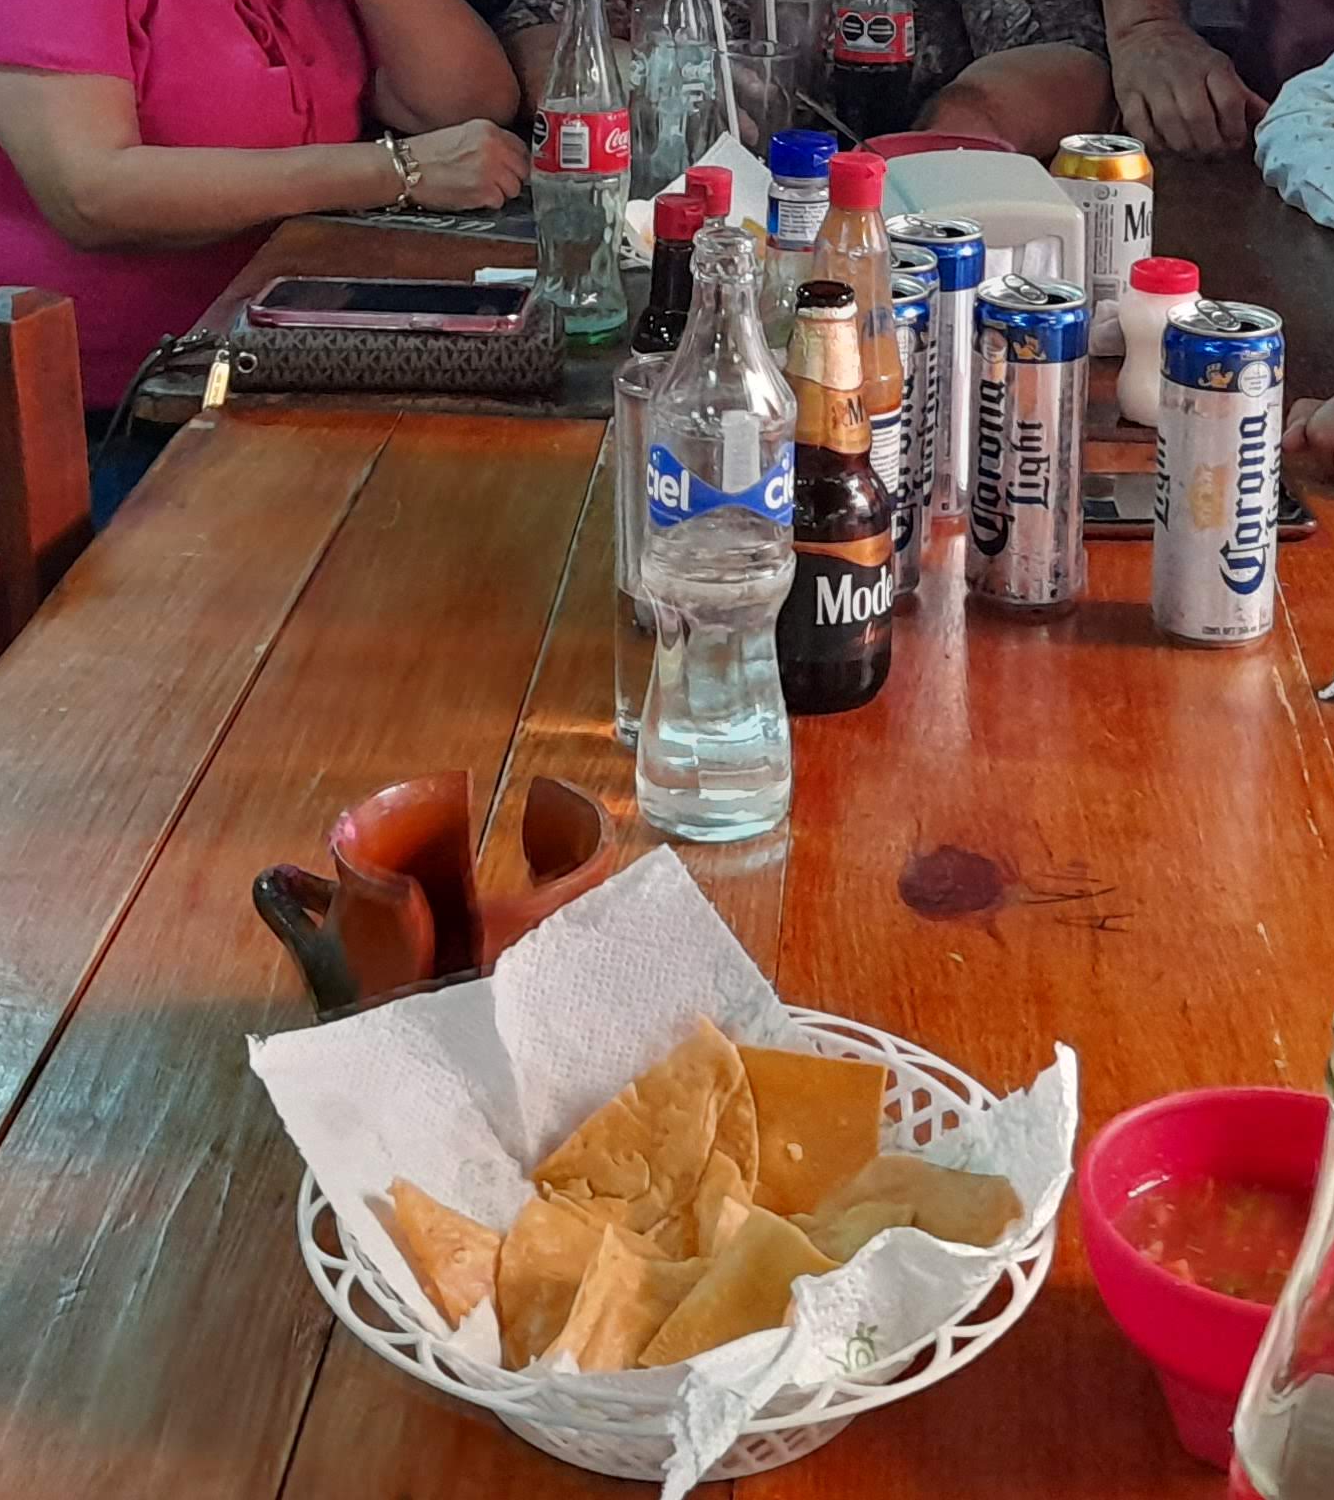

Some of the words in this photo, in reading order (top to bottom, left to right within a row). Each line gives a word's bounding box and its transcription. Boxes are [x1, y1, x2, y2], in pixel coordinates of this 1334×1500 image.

[647, 452, 691, 512] ciel
[971, 378, 1016, 557] Corona
[1006, 419, 1051, 510] Light
[1219, 409, 1270, 596] Corona
